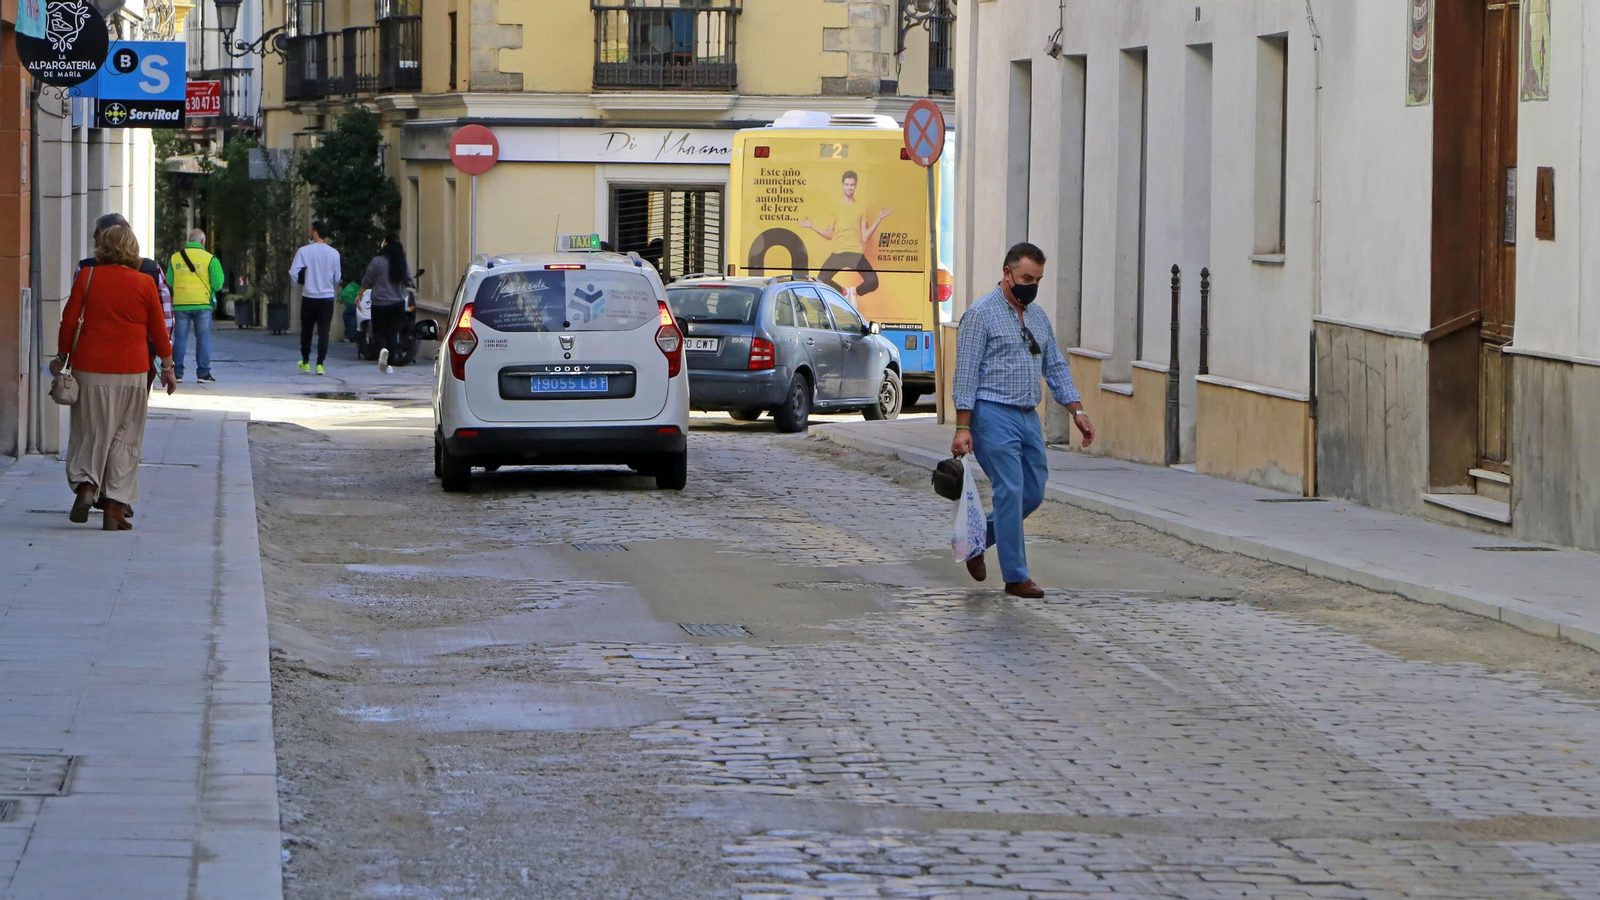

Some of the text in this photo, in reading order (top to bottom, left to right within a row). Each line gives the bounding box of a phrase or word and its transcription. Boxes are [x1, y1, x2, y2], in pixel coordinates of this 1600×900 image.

[28, 60, 96, 70] ALPARGATERÍA
[120, 54, 131, 68] B
[139, 54, 170, 94] S
[191, 96, 200, 110] 30
[202, 96, 210, 110] 47
[212, 96, 220, 110] 13
[129, 108, 180, 120] ServiRed
[597, 131, 638, 156] Di
[832, 143, 842, 158] 2
[760, 168, 801, 176] Este año
[754, 176, 807, 186] anunciarse
[780, 186, 794, 194] los
[756, 194, 804, 203] autobuses
[760, 203, 798, 213] de Jerez
[570, 236, 590, 248] TAXI
[696, 340, 714, 349] CWT
[542, 378, 606, 390] 9055 LBT
